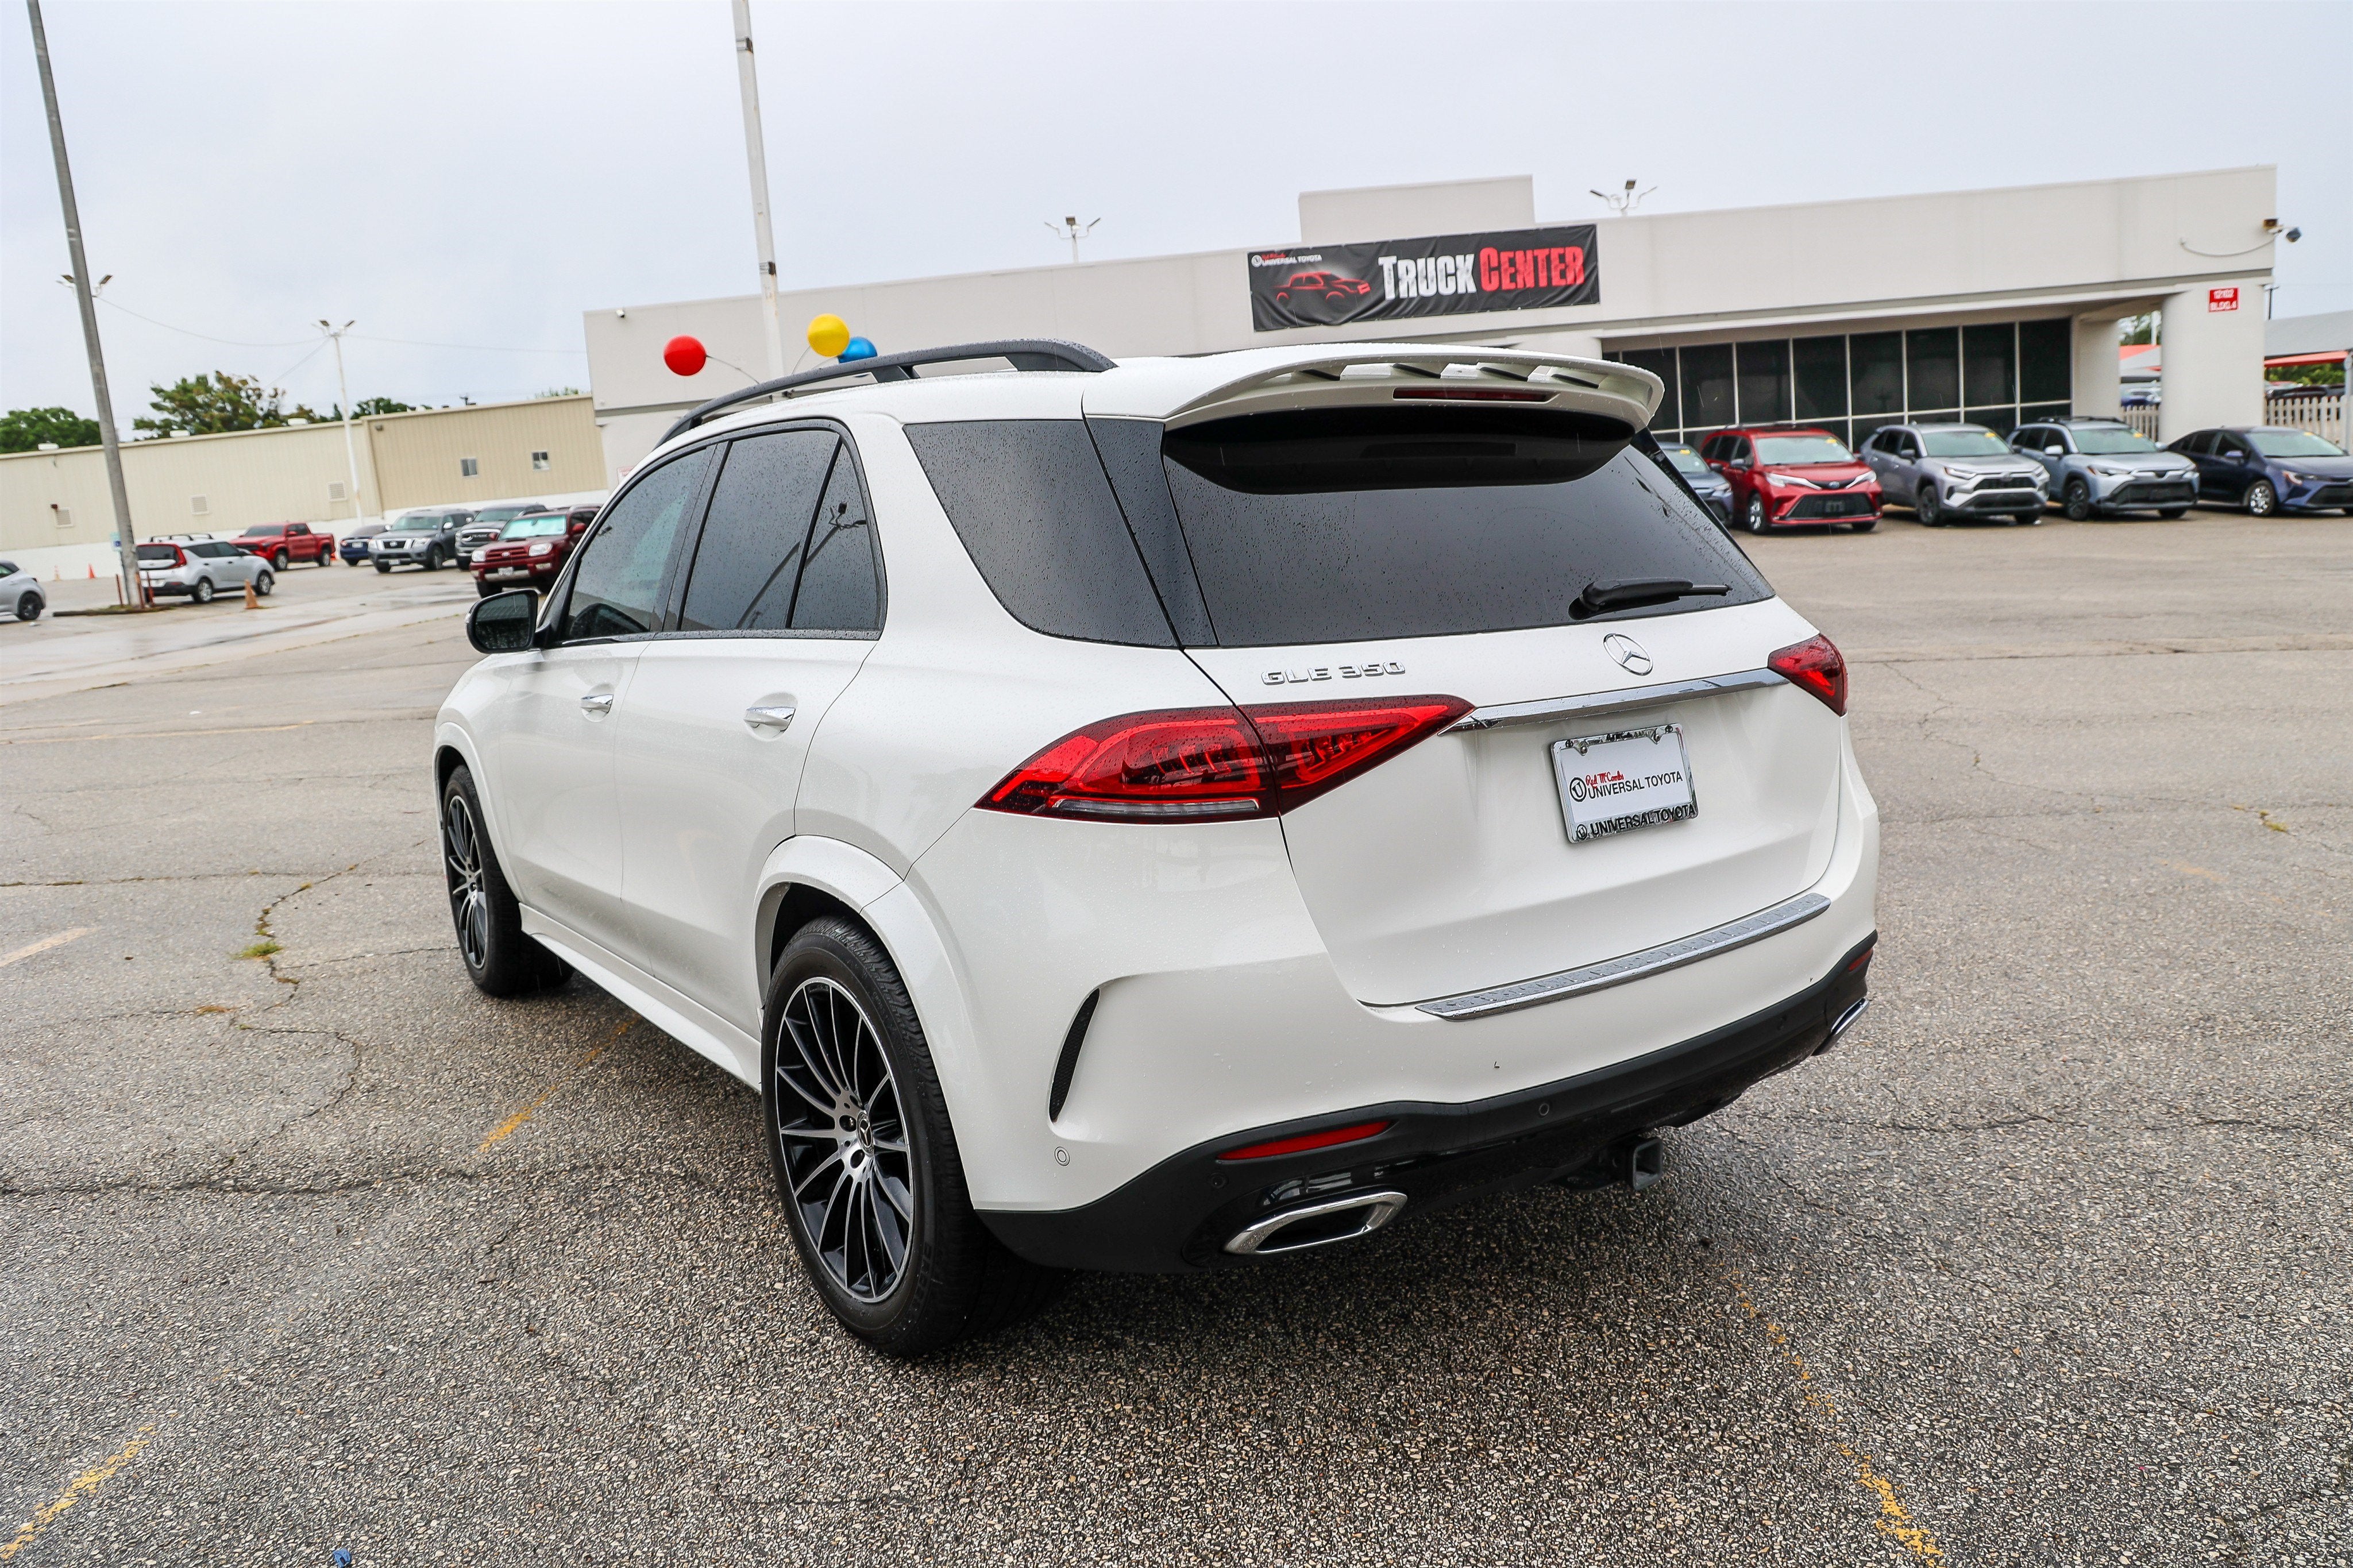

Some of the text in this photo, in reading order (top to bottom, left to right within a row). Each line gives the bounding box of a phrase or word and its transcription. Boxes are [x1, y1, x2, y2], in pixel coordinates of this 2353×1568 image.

[1378, 246, 1586, 300] TRUCK CENTER
[1261, 661, 1406, 685] GLE 350
[1588, 771, 1683, 800] UNIVERSAL TOYOTA
[1590, 804, 1696, 836] UNIVERSAL TOYOTA
